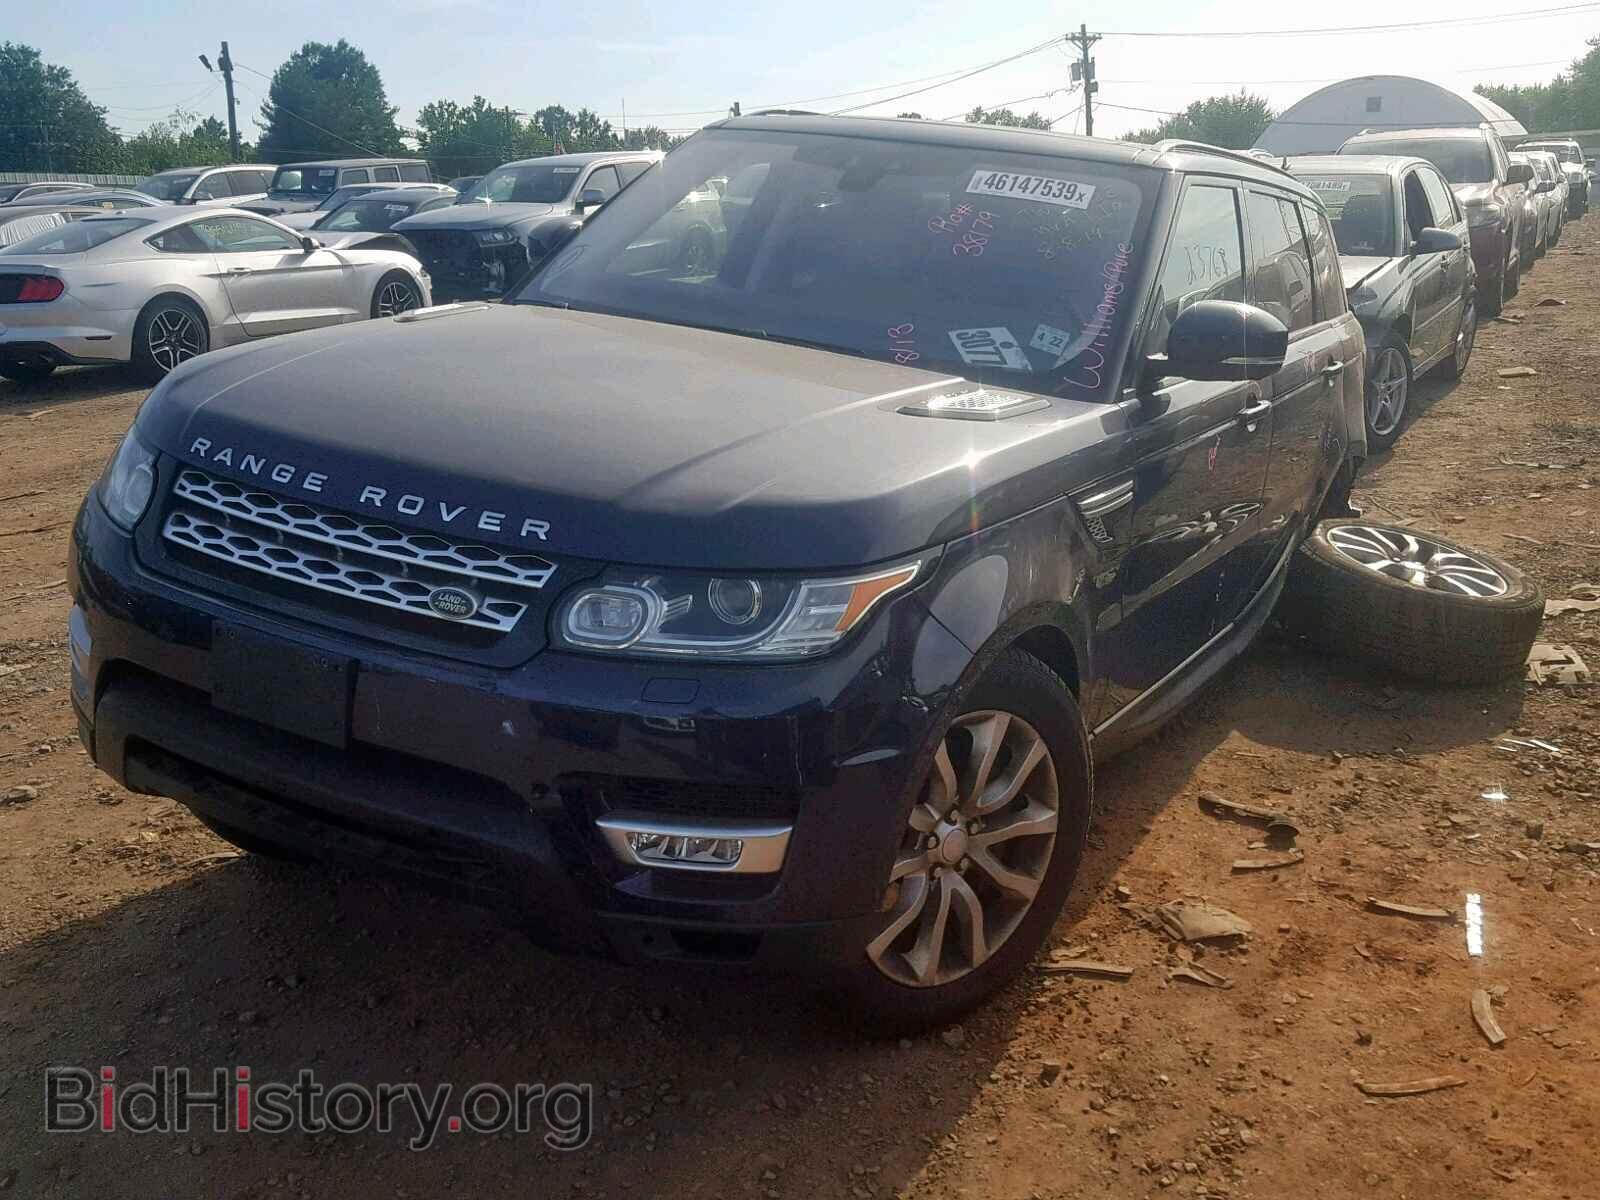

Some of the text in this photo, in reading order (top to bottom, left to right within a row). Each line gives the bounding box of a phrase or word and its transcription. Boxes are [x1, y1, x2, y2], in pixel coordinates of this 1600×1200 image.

[1048, 336, 1065, 349] 22
[190, 436, 552, 541] RANGE ROVER
[438, 592, 462, 604] LAND
[439, 600, 466, 615] ROVER
